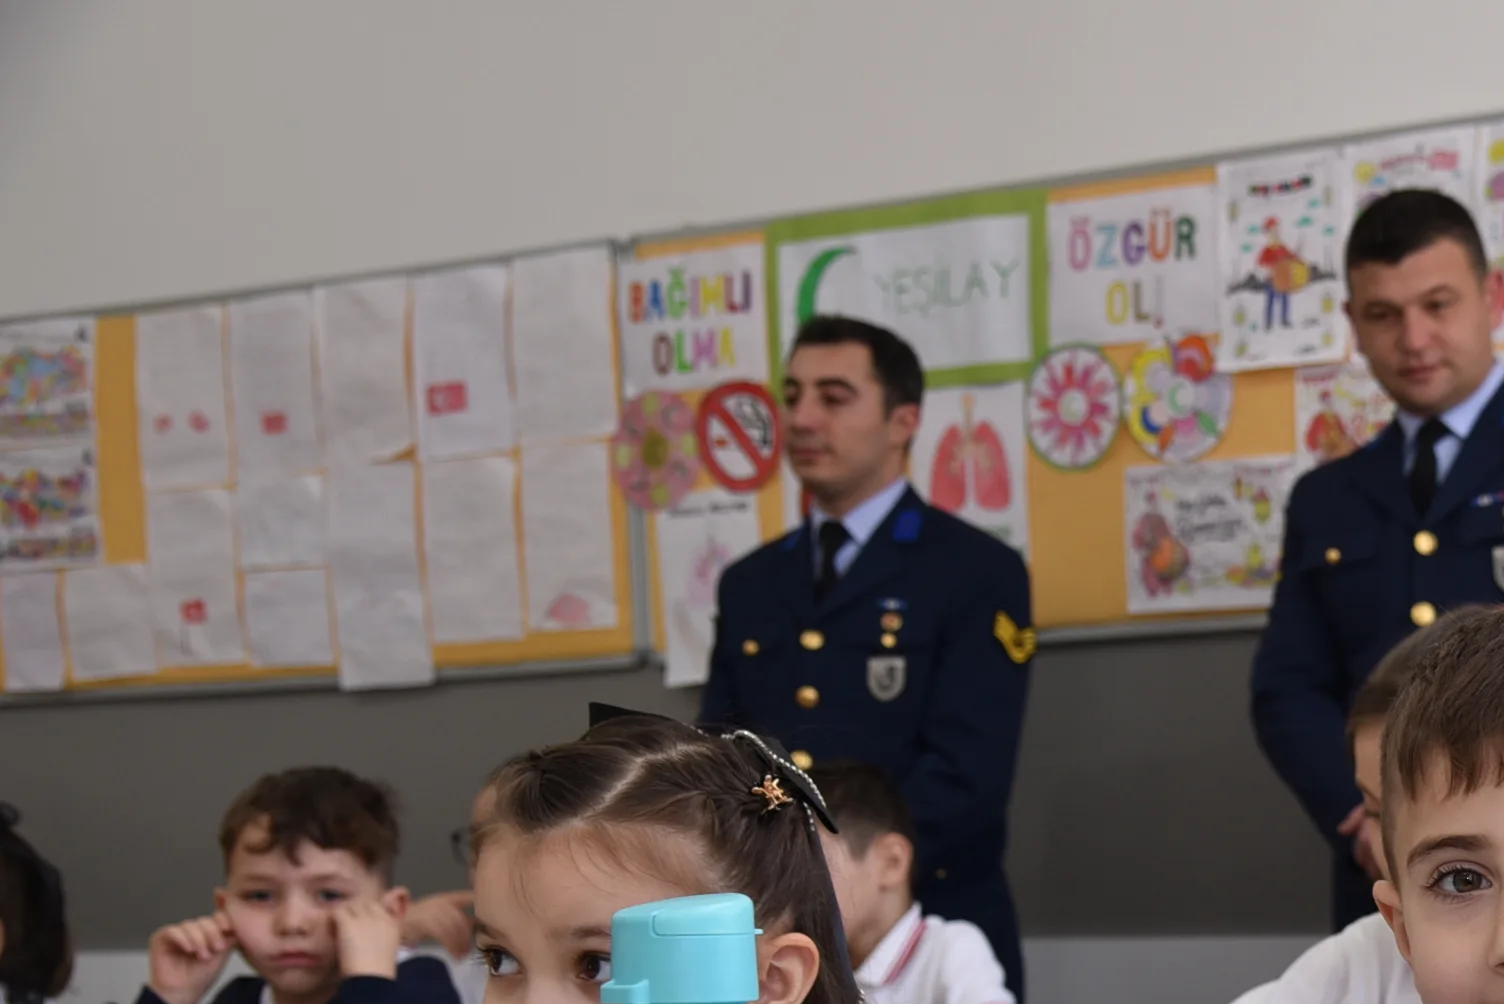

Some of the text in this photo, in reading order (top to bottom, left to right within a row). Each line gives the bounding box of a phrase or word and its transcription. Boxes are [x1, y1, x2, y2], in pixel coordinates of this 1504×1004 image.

[1067, 208, 1197, 272] ÖZGÜR
[628, 267, 752, 324] BAĞIMLI
[872, 256, 1020, 318] YEŞİLAY
[652, 327, 736, 376] OLMA
